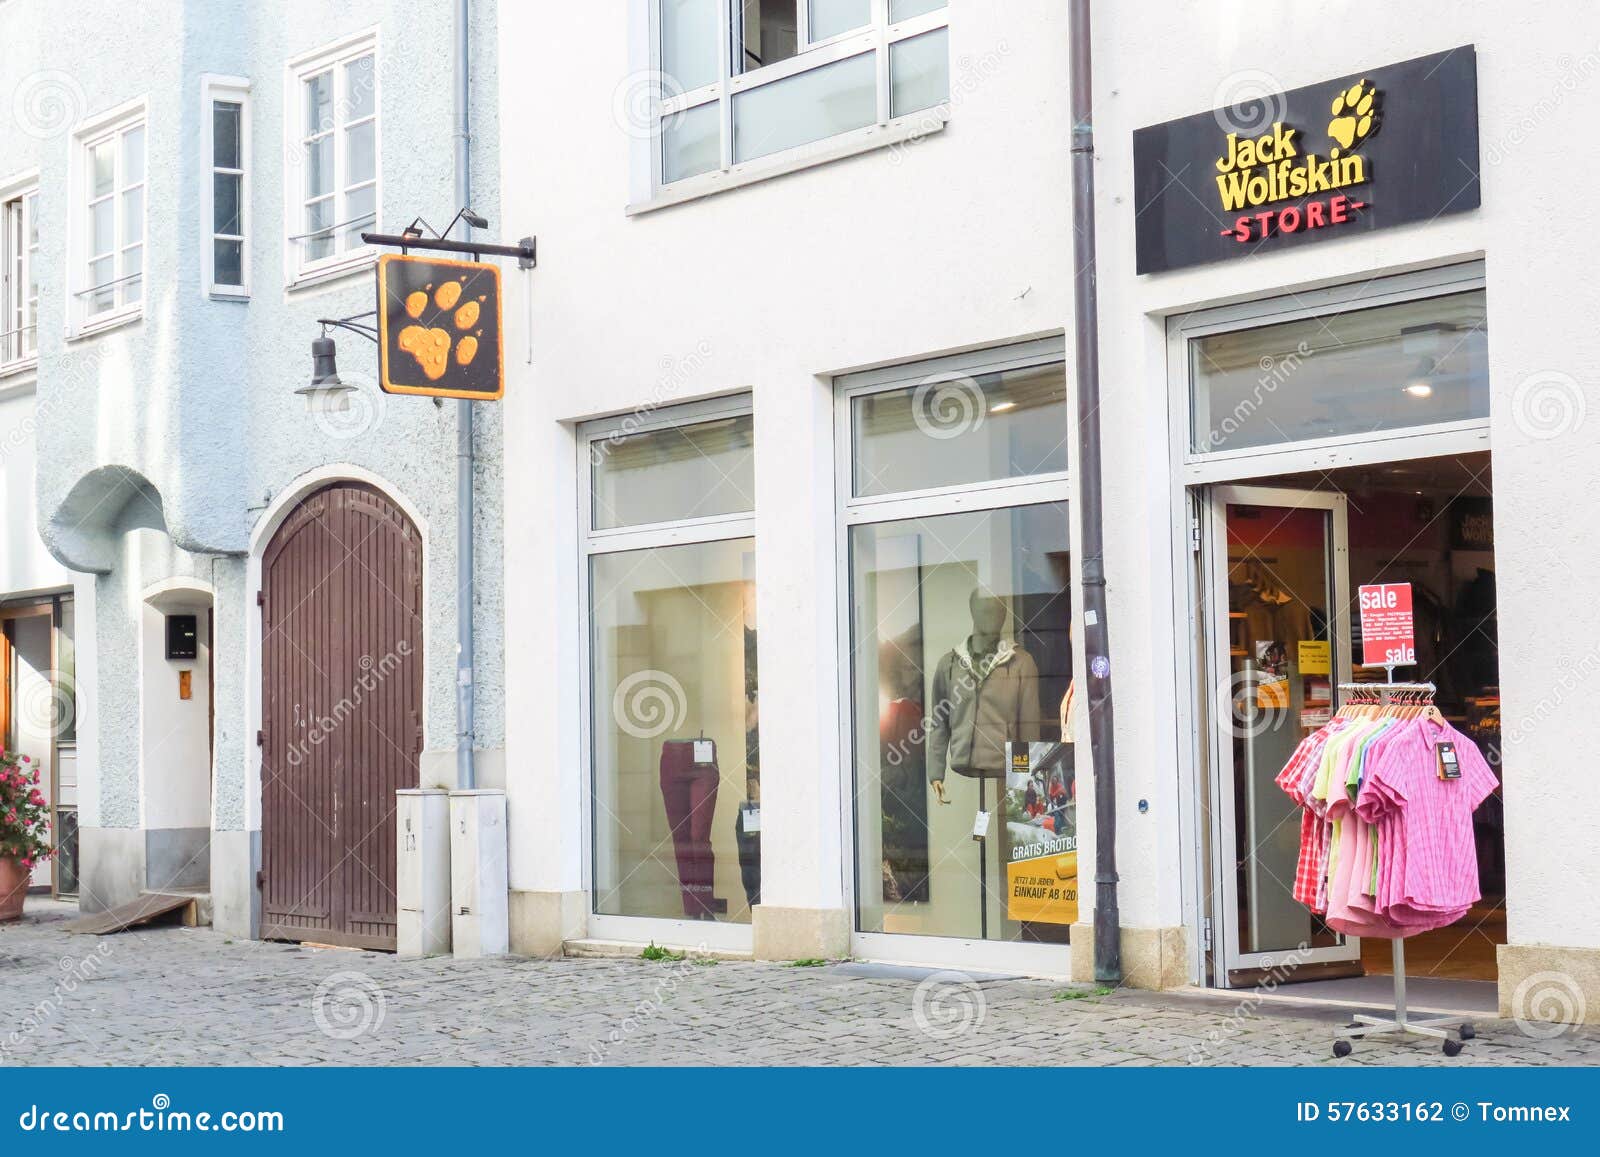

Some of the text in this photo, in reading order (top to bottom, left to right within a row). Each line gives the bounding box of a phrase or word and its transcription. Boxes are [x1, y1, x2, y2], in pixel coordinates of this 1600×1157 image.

[1216, 122, 1296, 172] Jack
[1216, 148, 1364, 211] Wolfskin
[1362, 585, 1397, 609] sale
[1385, 643, 1414, 662] sale
[1012, 842, 1042, 860] GRATIS
[1014, 886, 1076, 901] EINKAUF AB 120
